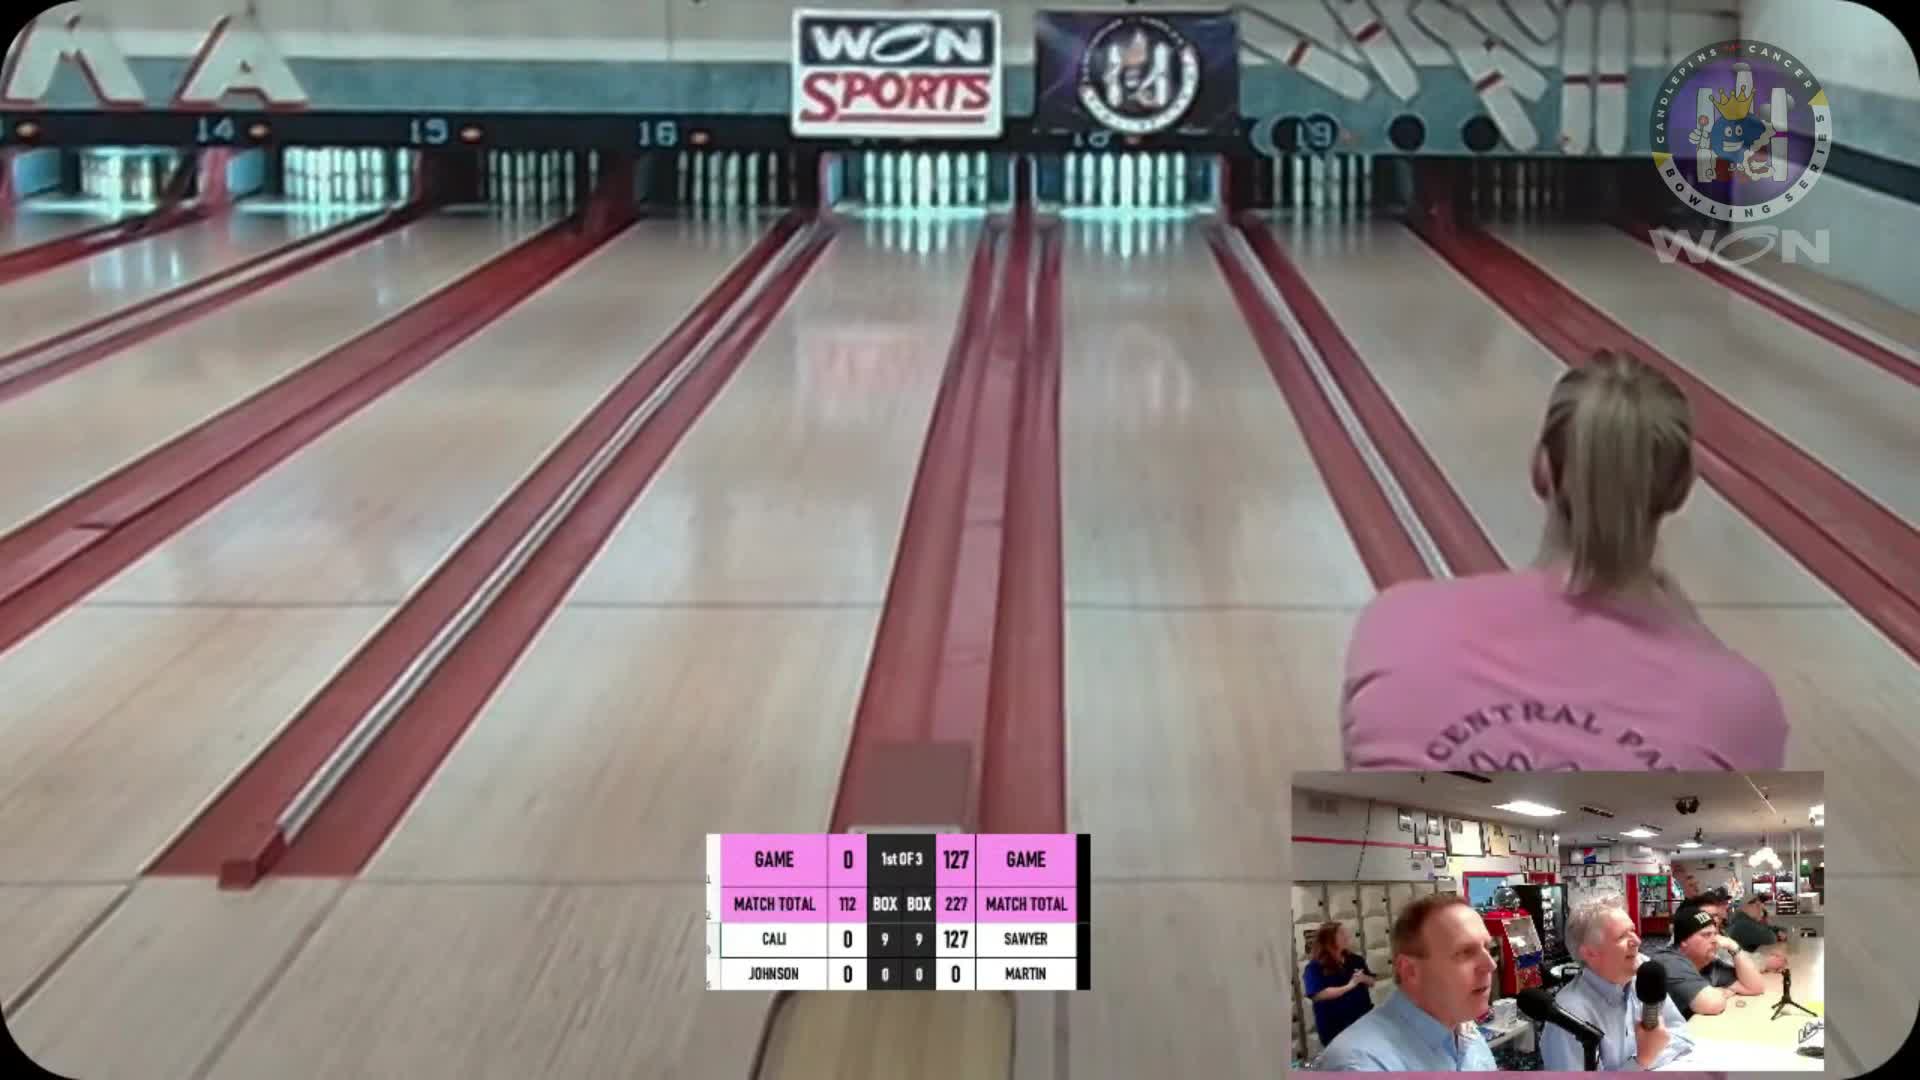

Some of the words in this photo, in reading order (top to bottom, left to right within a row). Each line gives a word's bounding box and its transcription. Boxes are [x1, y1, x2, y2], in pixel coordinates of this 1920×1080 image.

[811, 23, 984, 63] WON
[801, 71, 992, 123] SPORTS
[195, 117, 236, 142] 14
[638, 120, 679, 146] 16
[1296, 121, 1332, 146] 19
[1425, 700, 1603, 762] CENTRAL
[1616, 729, 1678, 771] PA
